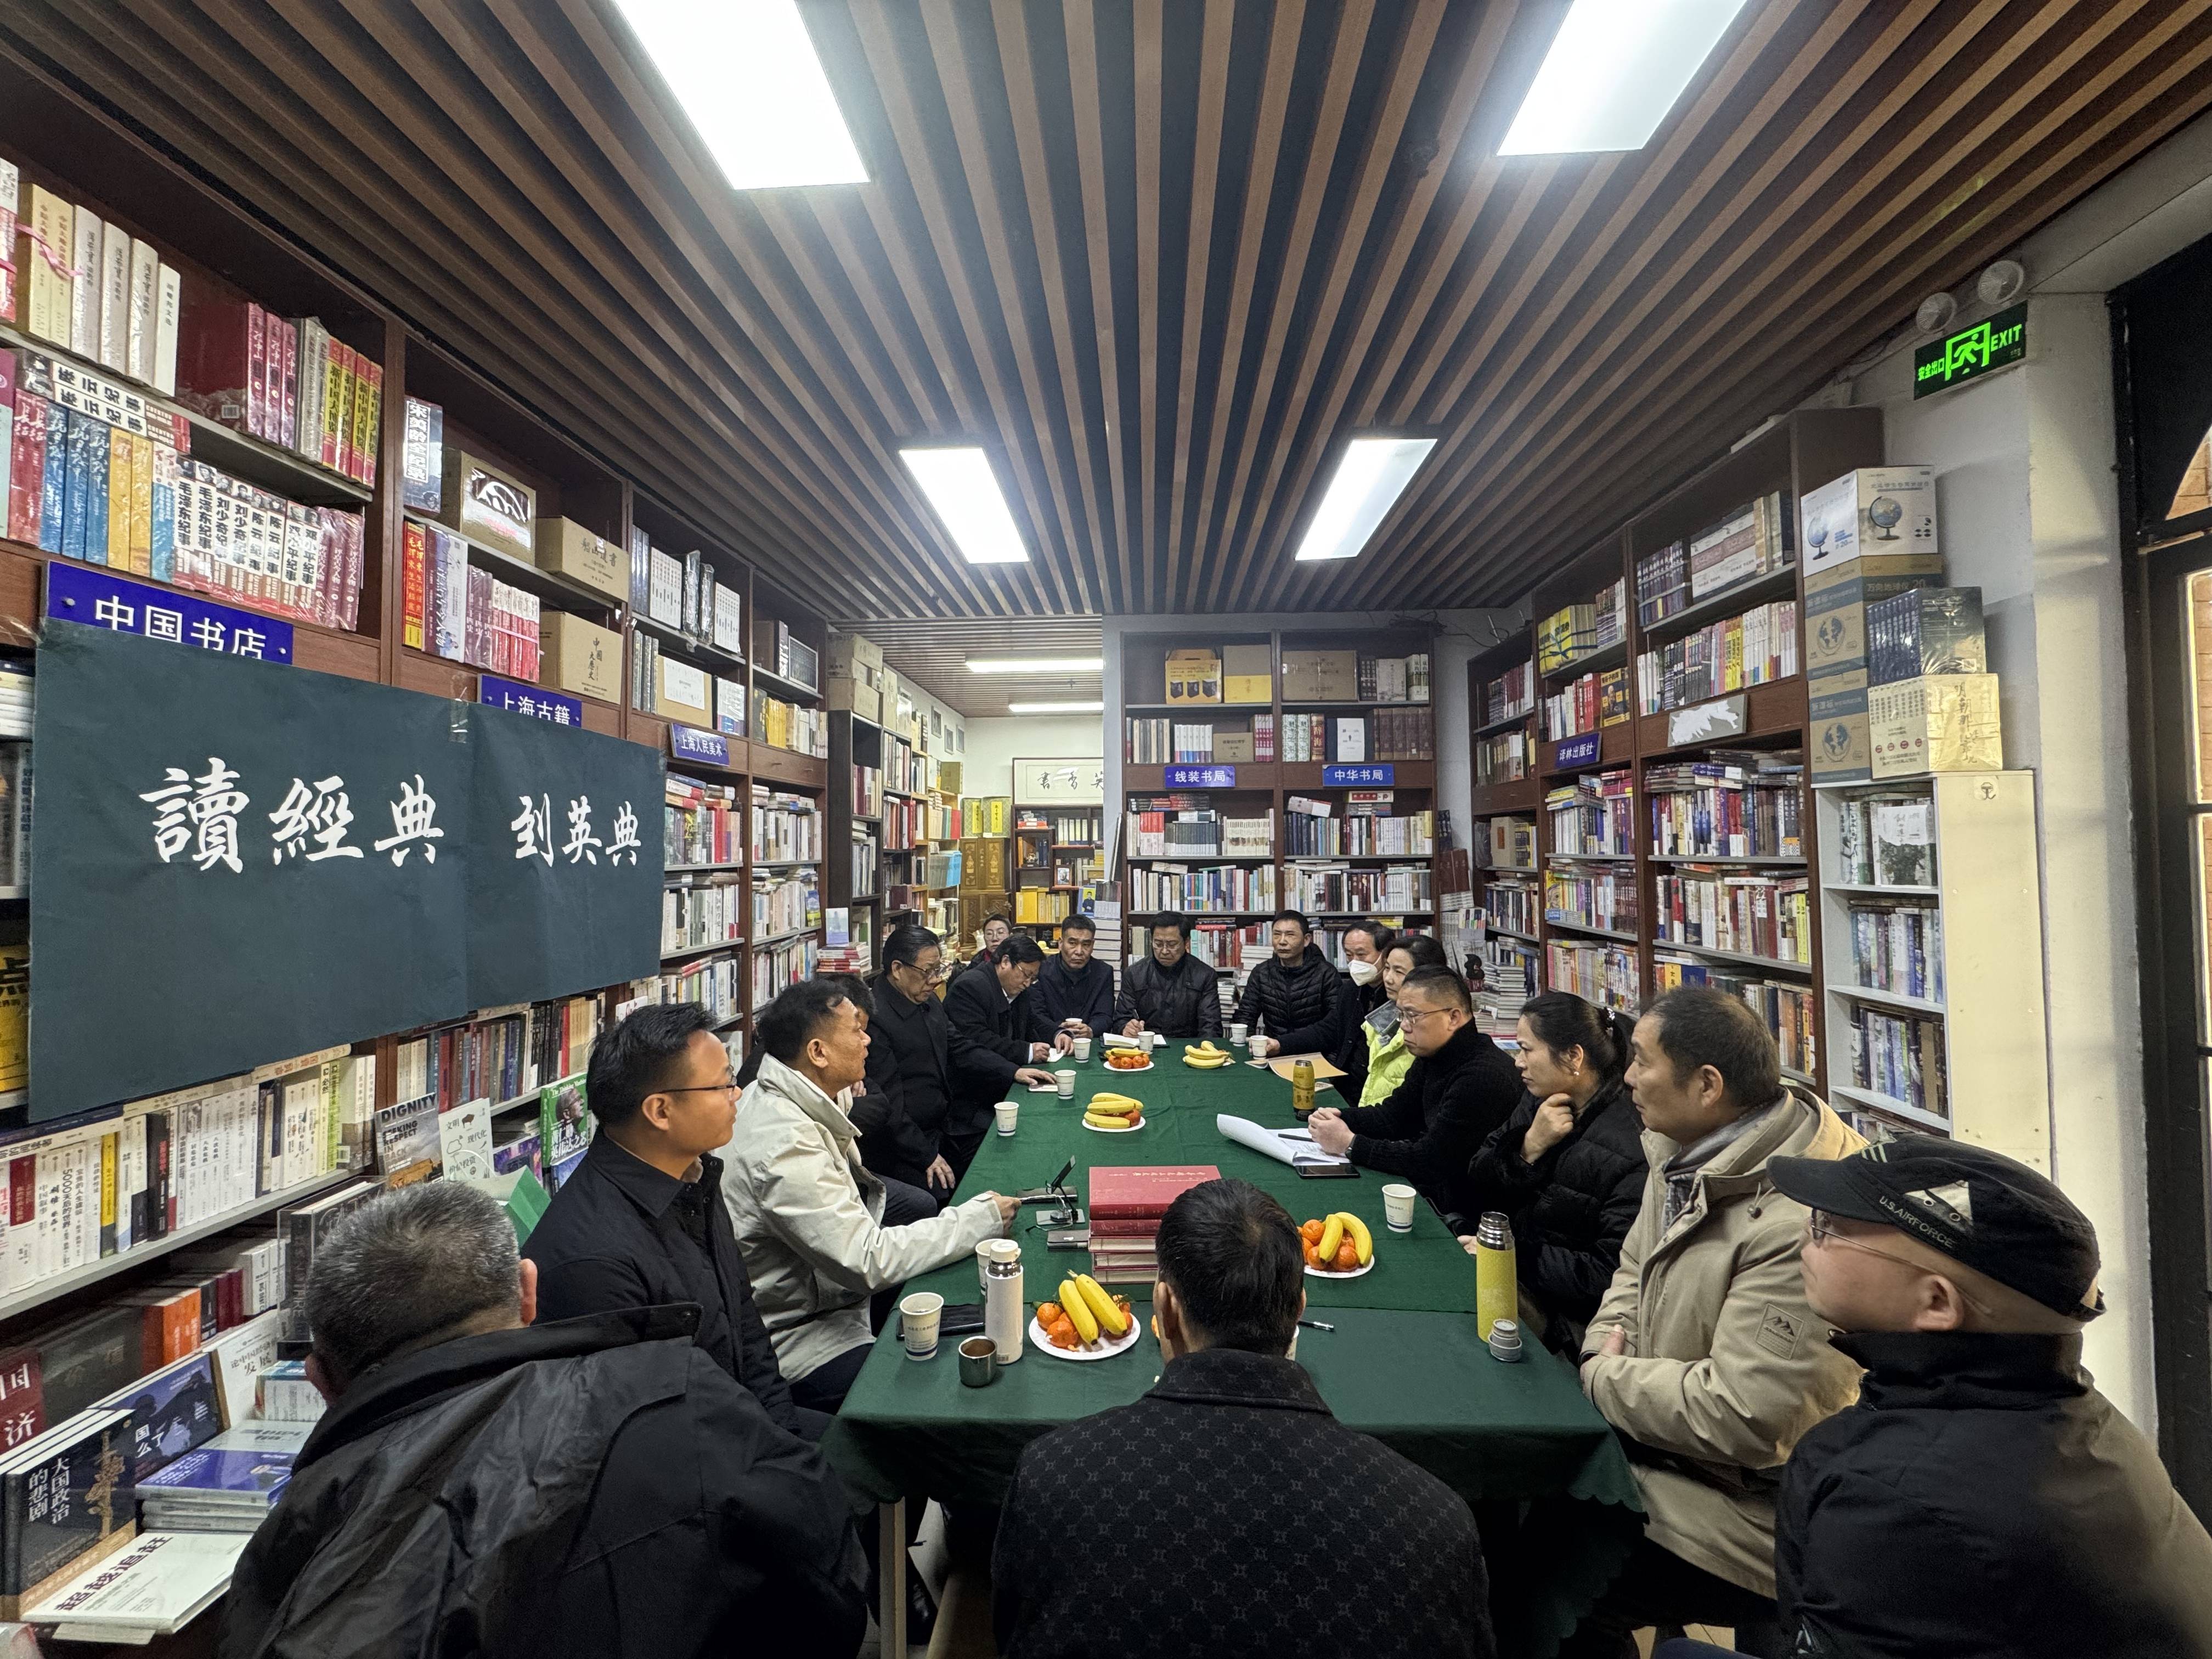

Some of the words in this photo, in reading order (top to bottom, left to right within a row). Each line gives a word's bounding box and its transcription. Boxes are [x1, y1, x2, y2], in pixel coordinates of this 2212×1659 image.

[1990, 324, 2022, 352] EXIT
[58, 366, 140, 413] 陈云纪事
[1918, 358, 1945, 381] 安全出口
[61, 388, 143, 432] 陈云纪事
[178, 481, 191, 545] 毛泽东纪事
[198, 486, 212, 550] 毛泽东纪事
[215, 498, 230, 559] 刘少奇纪事
[233, 504, 249, 564] 刘少奇纪事
[250, 512, 264, 571] 陈云纪事
[266, 516, 282, 575] 陈云纪事
[285, 524, 300, 582] 邓小平纪事
[301, 529, 317, 584] 邓小平纪事
[94, 595, 266, 660] 中国书店
[504, 692, 571, 726] 上海古籍
[681, 735, 723, 757] 上海人民美术
[1559, 742, 1594, 761] 译林出版社
[1175, 770, 1226, 783] 线装书局
[1334, 769, 1384, 781] 中华书局
[139, 757, 445, 873] 讀經典
[511, 793, 642, 867] 到英典
[381, 1093, 436, 1124] DIGNITY
[445, 1118, 460, 1132] 文明
[384, 1128, 417, 1146] RESPECT
[28, 1468, 49, 1522] 的悲剧
[51, 1457, 71, 1525] 大国政治
